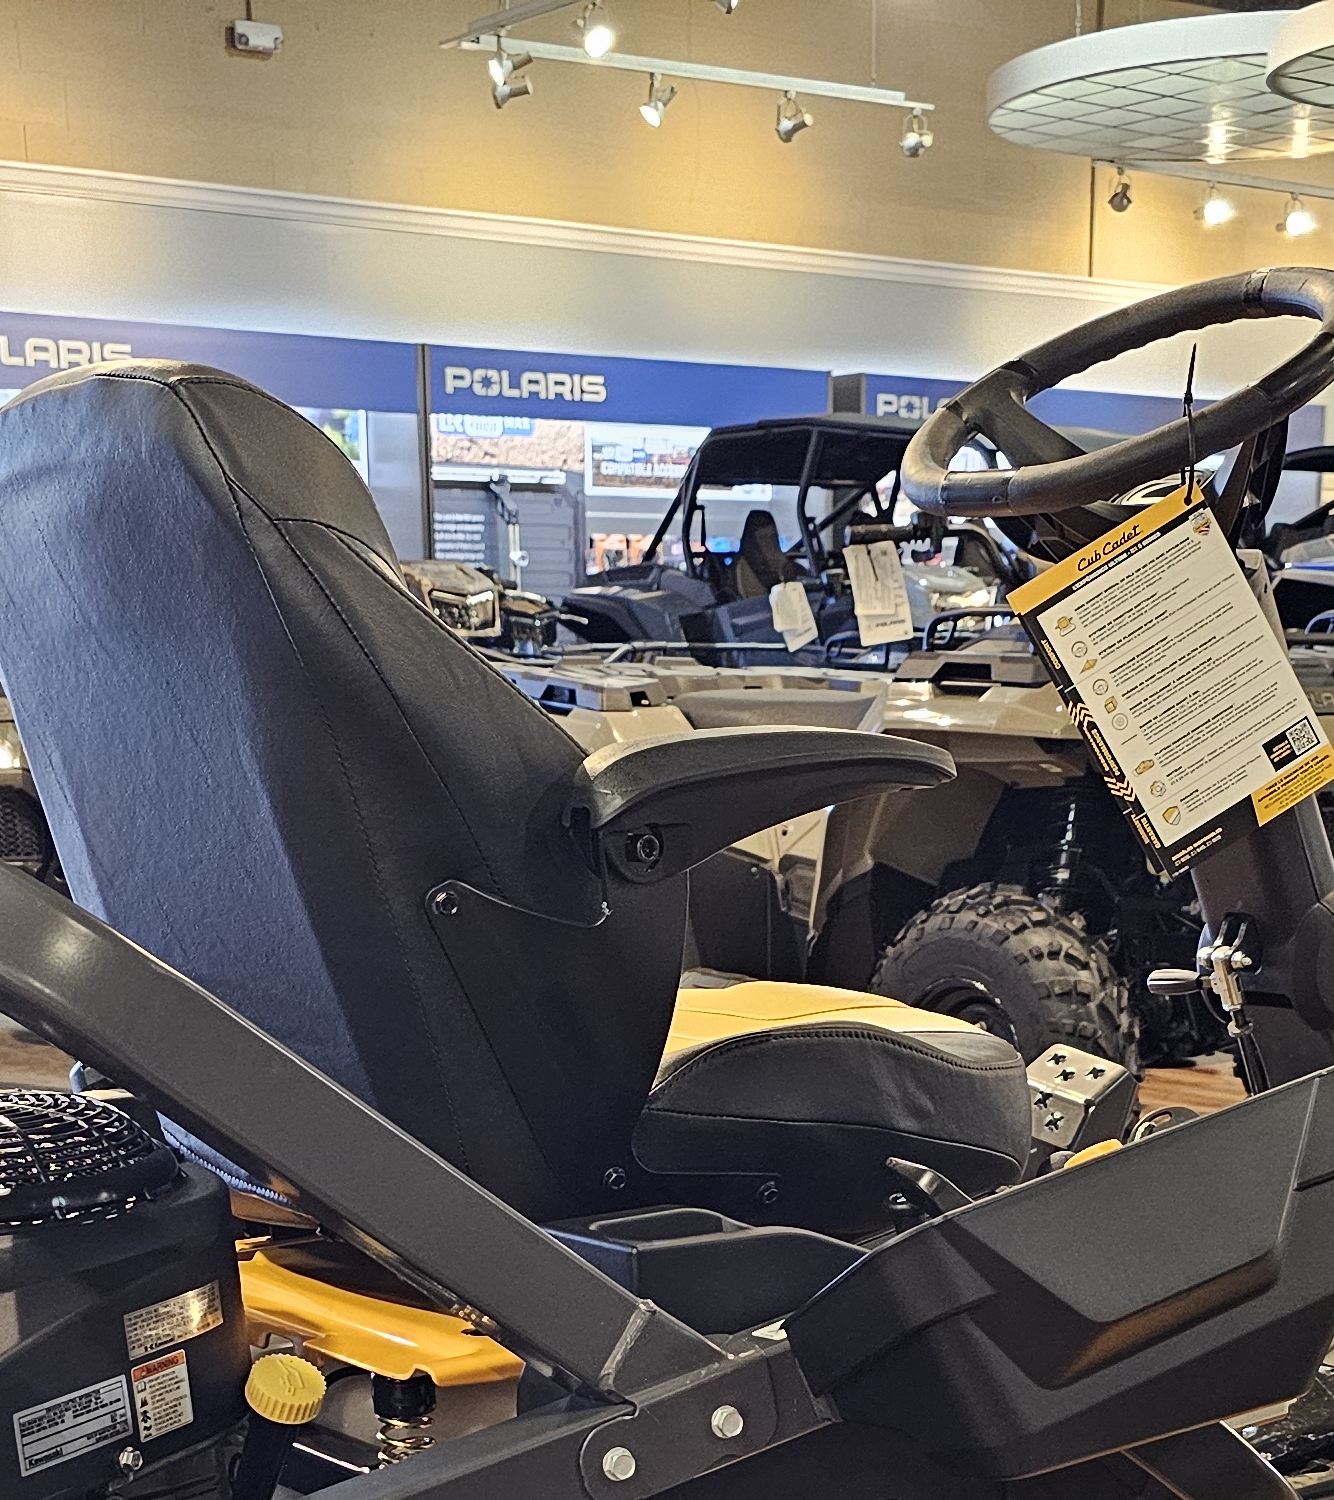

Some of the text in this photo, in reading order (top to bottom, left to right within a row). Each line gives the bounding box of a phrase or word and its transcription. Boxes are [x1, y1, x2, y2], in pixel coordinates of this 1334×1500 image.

[444, 366, 607, 403] POLARIS
[1077, 550, 1102, 573] Cub
[1102, 524, 1144, 556] Cadet
[147, 1355, 179, 1373] WARNING
